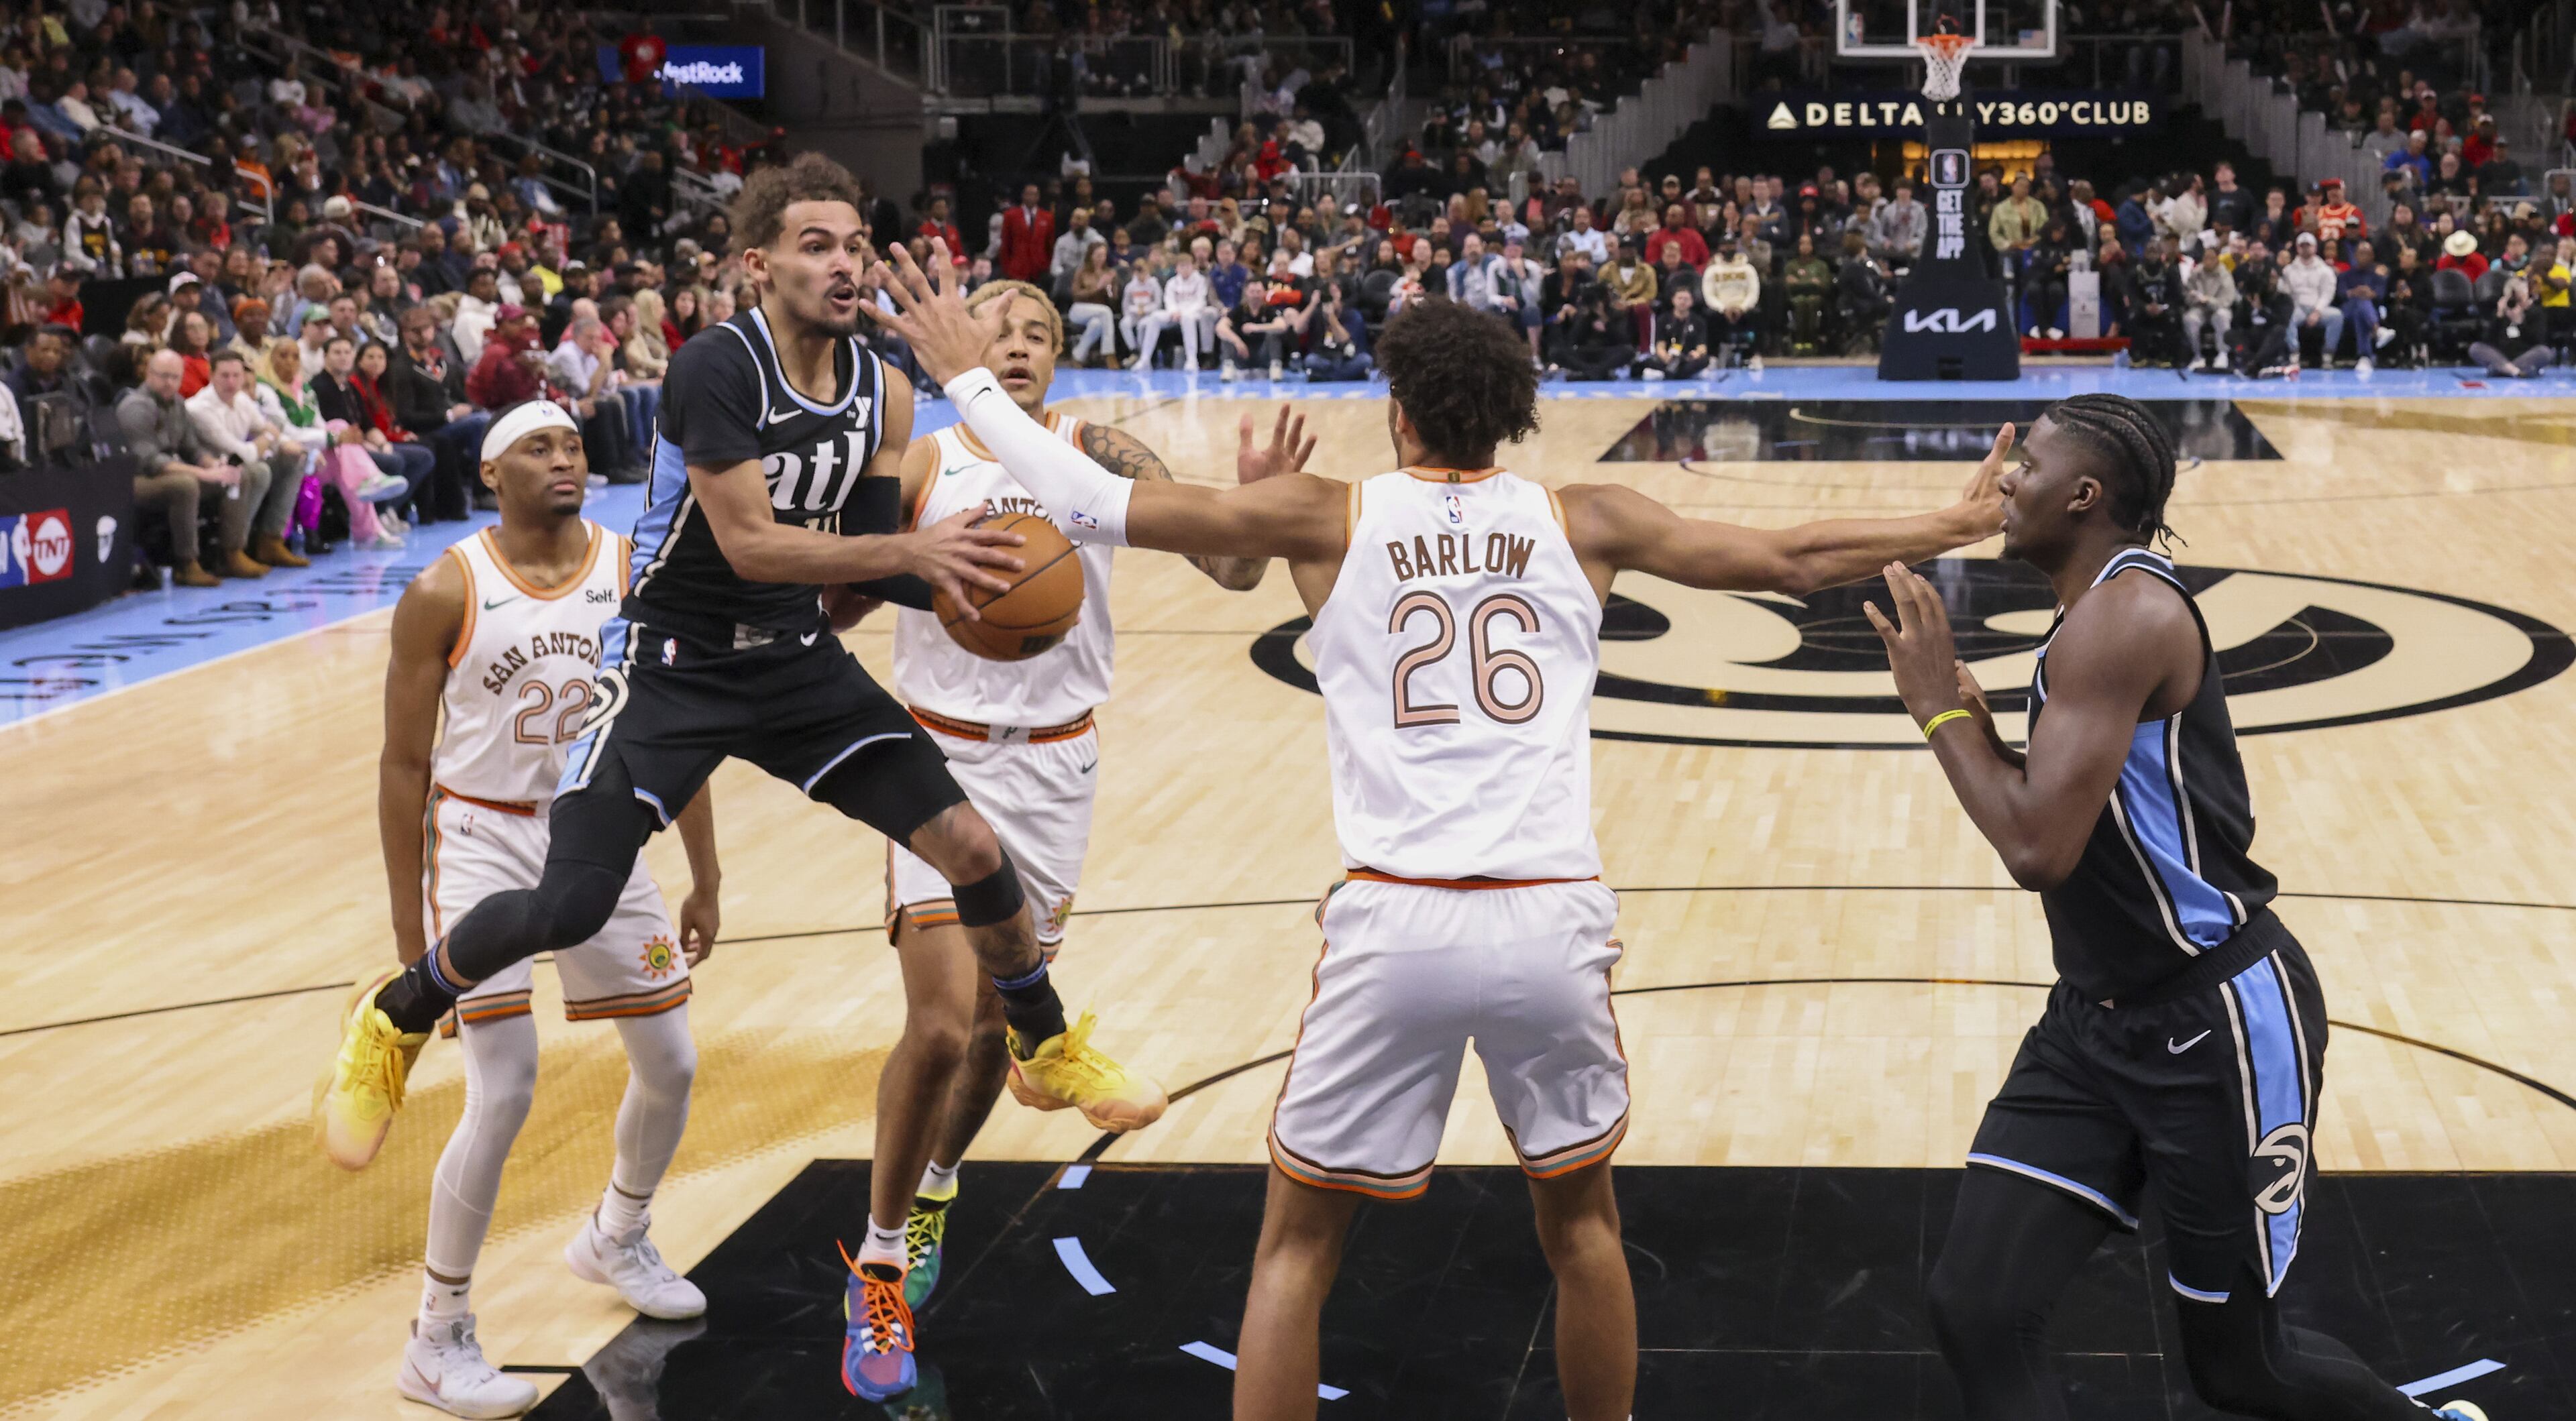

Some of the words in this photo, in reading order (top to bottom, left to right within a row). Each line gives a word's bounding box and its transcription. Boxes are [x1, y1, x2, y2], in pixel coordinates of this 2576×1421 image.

[1806, 102, 1923, 126] DELTA
[1936, 189, 1964, 213] GET
[1936, 213, 1964, 235] THE
[1936, 236, 1966, 260] APP
[1904, 308, 1996, 333] KIA
[761, 431, 866, 512] atl
[983, 498, 1058, 528] ANTO
[34, 537, 66, 559] TNT
[1386, 532, 1536, 582] BARLOW
[586, 589, 617, 604] Self.
[483, 645, 528, 696] SAN
[531, 632, 602, 669] ANTON
[1389, 590, 1544, 729] 26
[515, 679, 592, 745] 22
